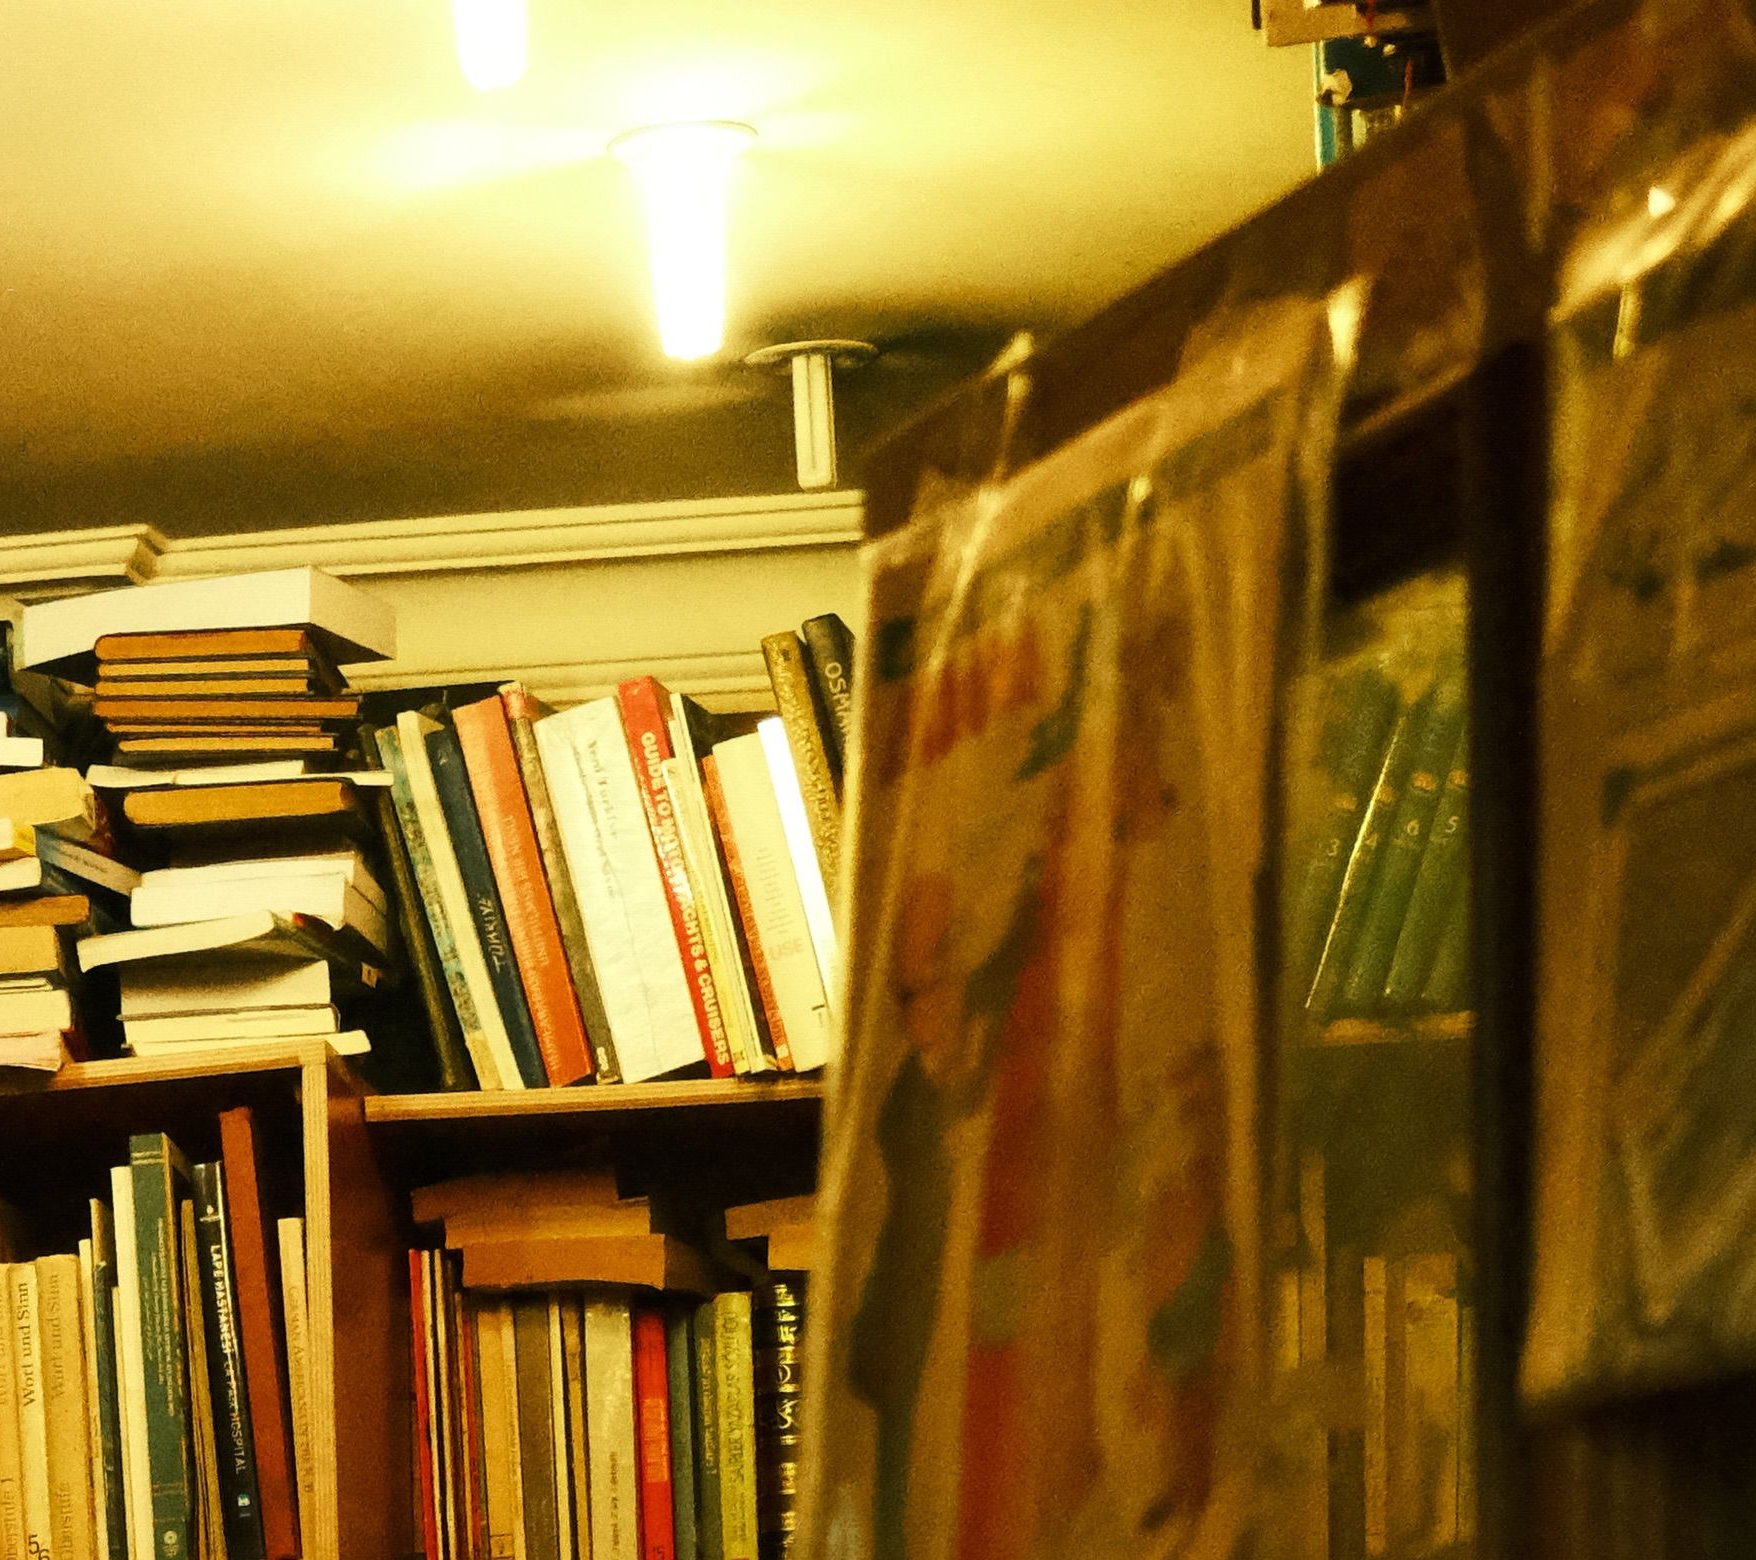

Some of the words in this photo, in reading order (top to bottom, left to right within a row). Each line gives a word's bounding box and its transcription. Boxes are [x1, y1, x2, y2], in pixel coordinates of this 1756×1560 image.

[640, 731, 664, 790] GUIDE
[699, 983, 733, 1075] CRUISERS
[16, 1282, 30, 1321] Sinn
[18, 1325, 32, 1357] und
[21, 1363, 37, 1407] Wort
[230, 1412, 246, 1474] HOSPITAL
